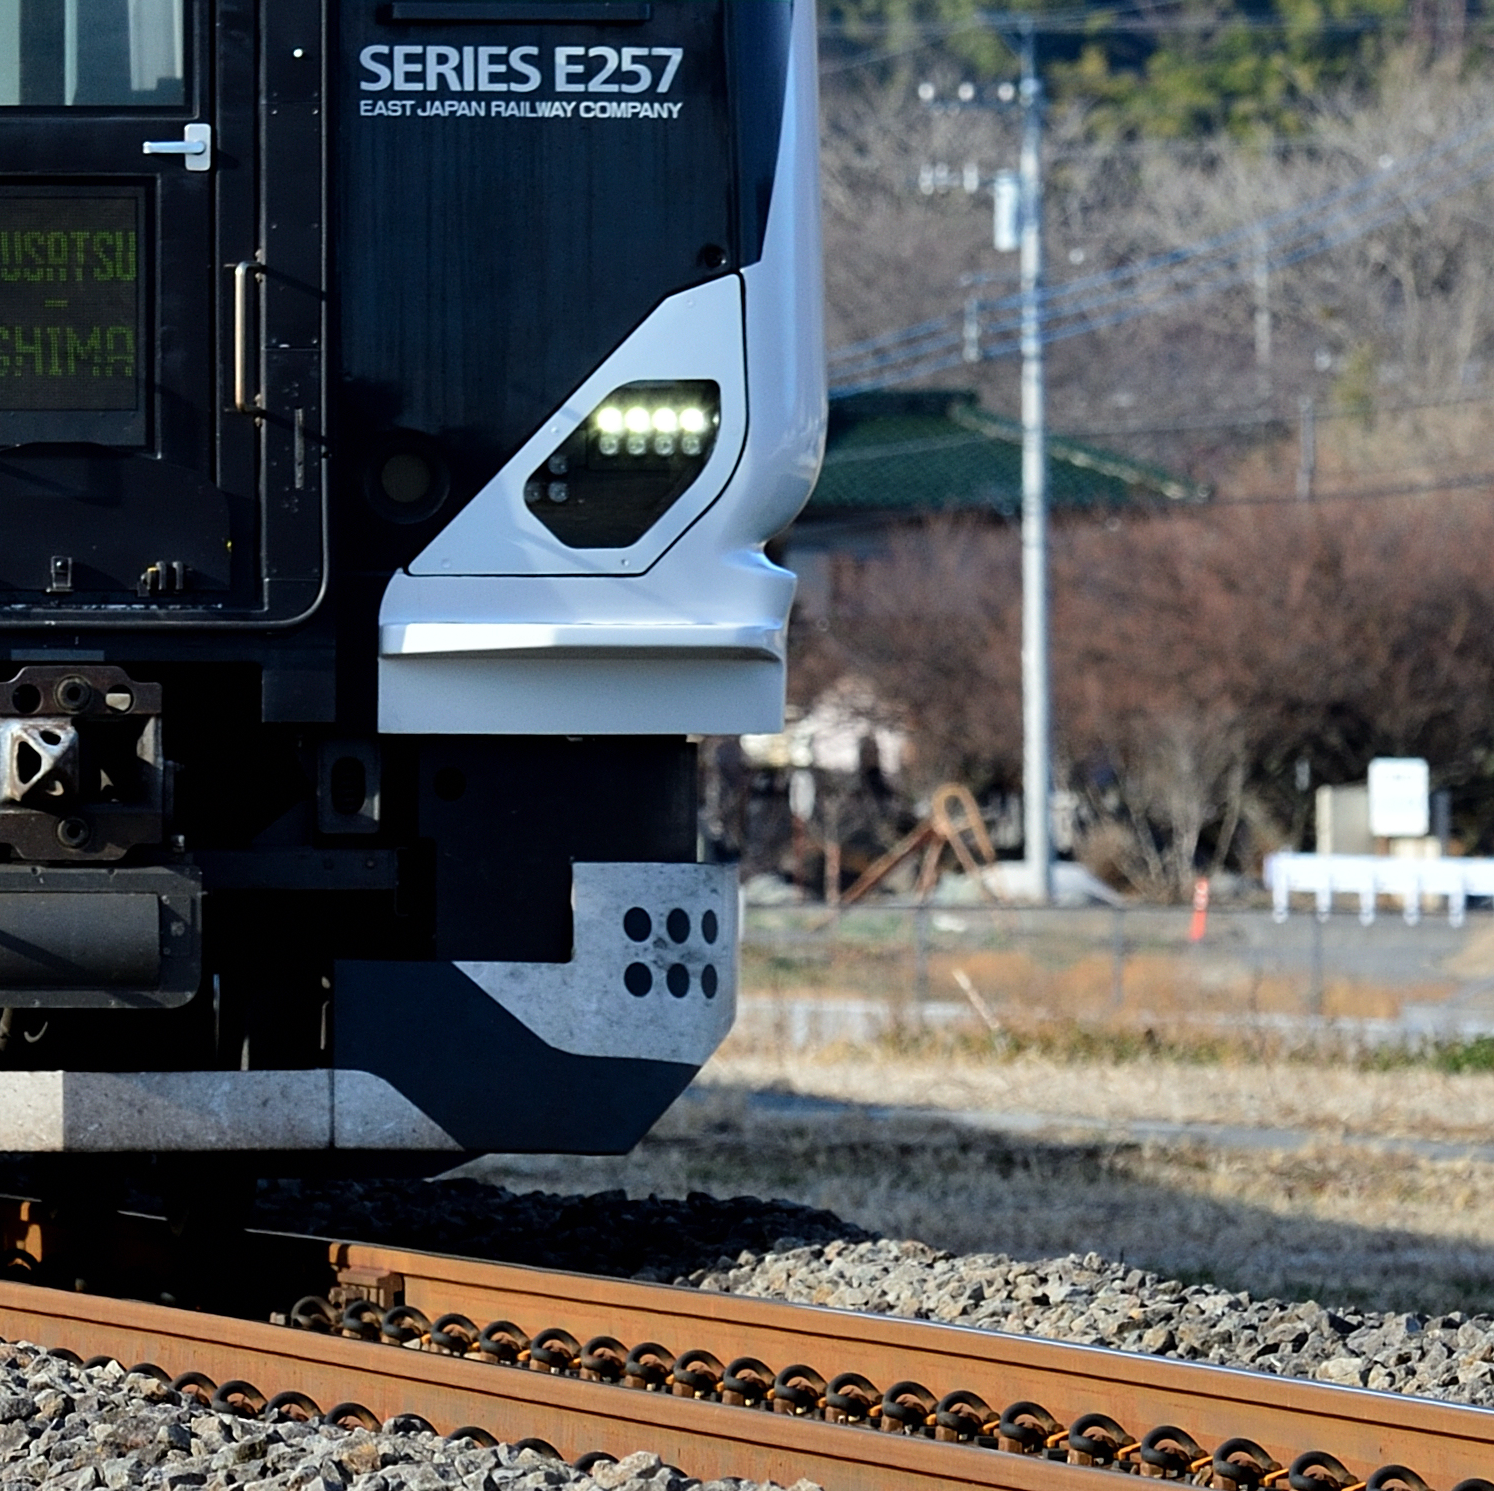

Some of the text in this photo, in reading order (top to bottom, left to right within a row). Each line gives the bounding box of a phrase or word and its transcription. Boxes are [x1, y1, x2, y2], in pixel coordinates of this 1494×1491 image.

[359, 44, 684, 94] SERIES E257
[359, 100, 683, 119] EAST JAPAN RAILWAY COMPANY
